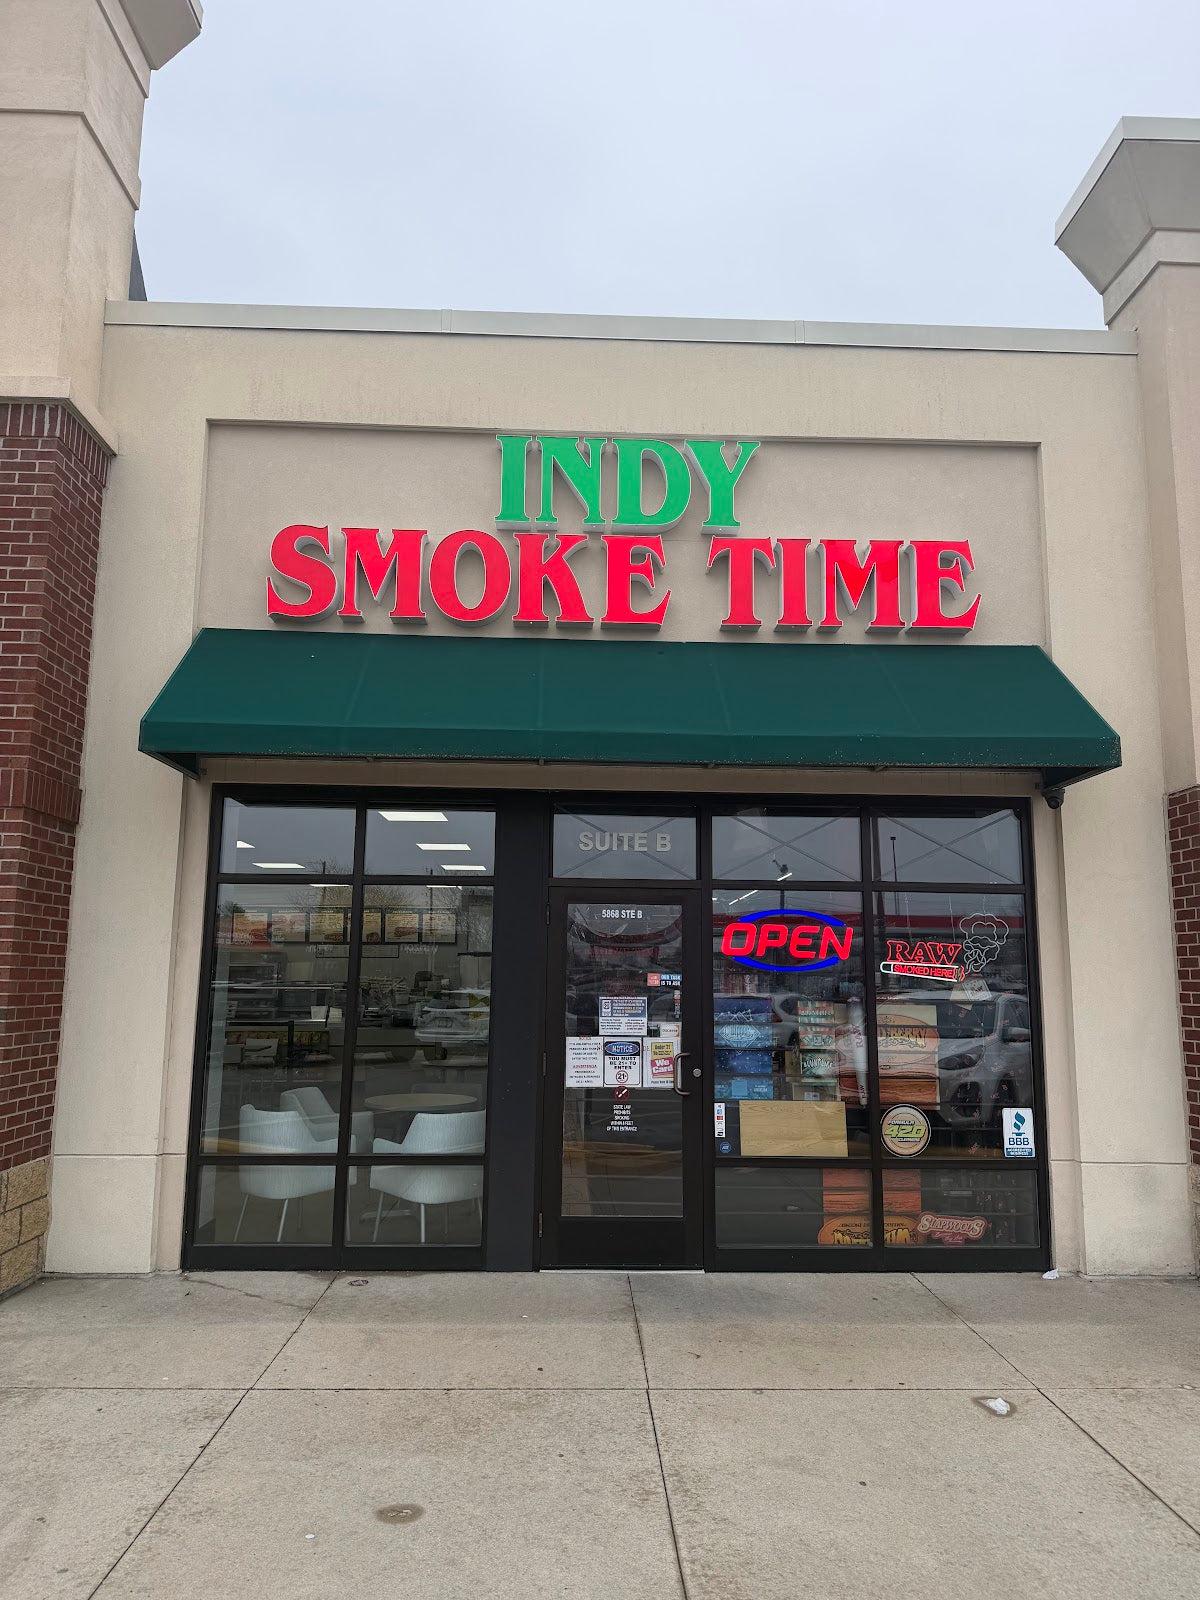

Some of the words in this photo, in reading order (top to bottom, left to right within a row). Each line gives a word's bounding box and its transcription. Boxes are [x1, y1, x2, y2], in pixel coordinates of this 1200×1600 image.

[495, 435, 760, 532] INDY
[267, 524, 671, 630] SMOKE
[707, 537, 981, 634] TIME
[579, 831, 648, 852] SUITE
[656, 833, 672, 852] B
[602, 909, 620, 918] 5868
[621, 910, 636, 919] STE
[637, 910, 643, 919] B
[721, 923, 853, 960] OPEN
[887, 940, 962, 965] RAW
[893, 965, 930, 977] SMOKED
[930, 968, 955, 980] HERE
[653, 1064, 673, 1073] Card
[655, 1059, 670, 1067] We
[884, 1125, 926, 1138] 420
[1008, 1137, 1030, 1145] BBB
